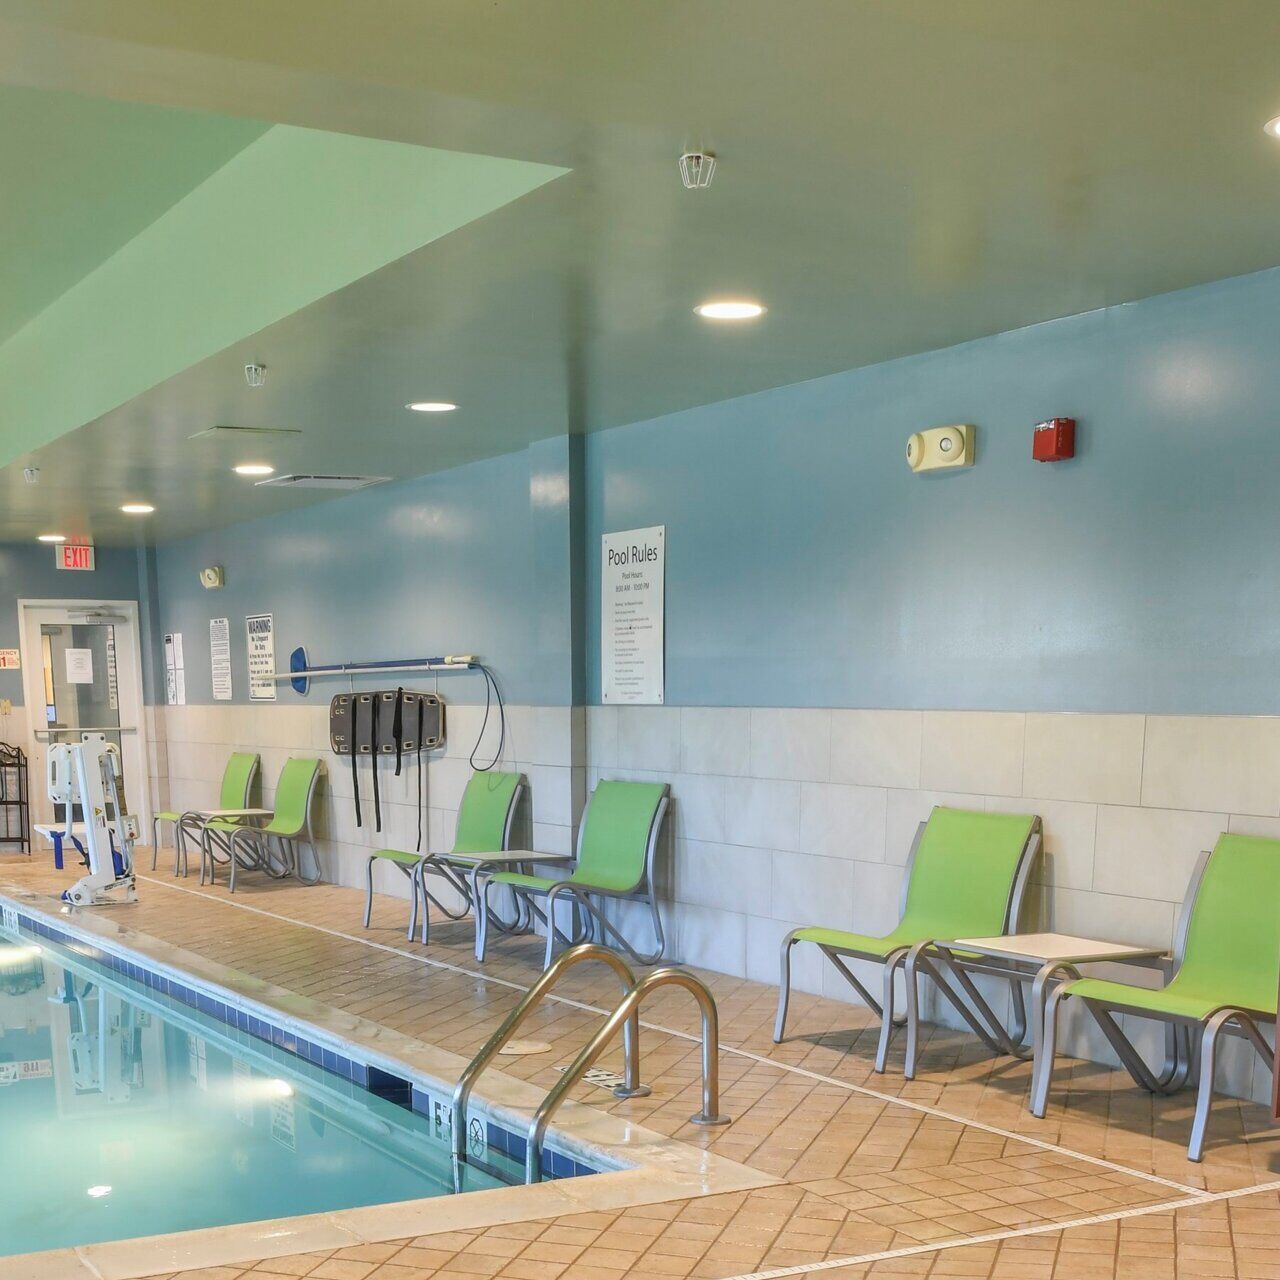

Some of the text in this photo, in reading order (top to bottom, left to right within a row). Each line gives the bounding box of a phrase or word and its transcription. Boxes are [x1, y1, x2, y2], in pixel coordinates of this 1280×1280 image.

[63, 546, 90, 568] EXIT
[608, 543, 658, 566] Pool Rules
[248, 619, 271, 634] WARNING
